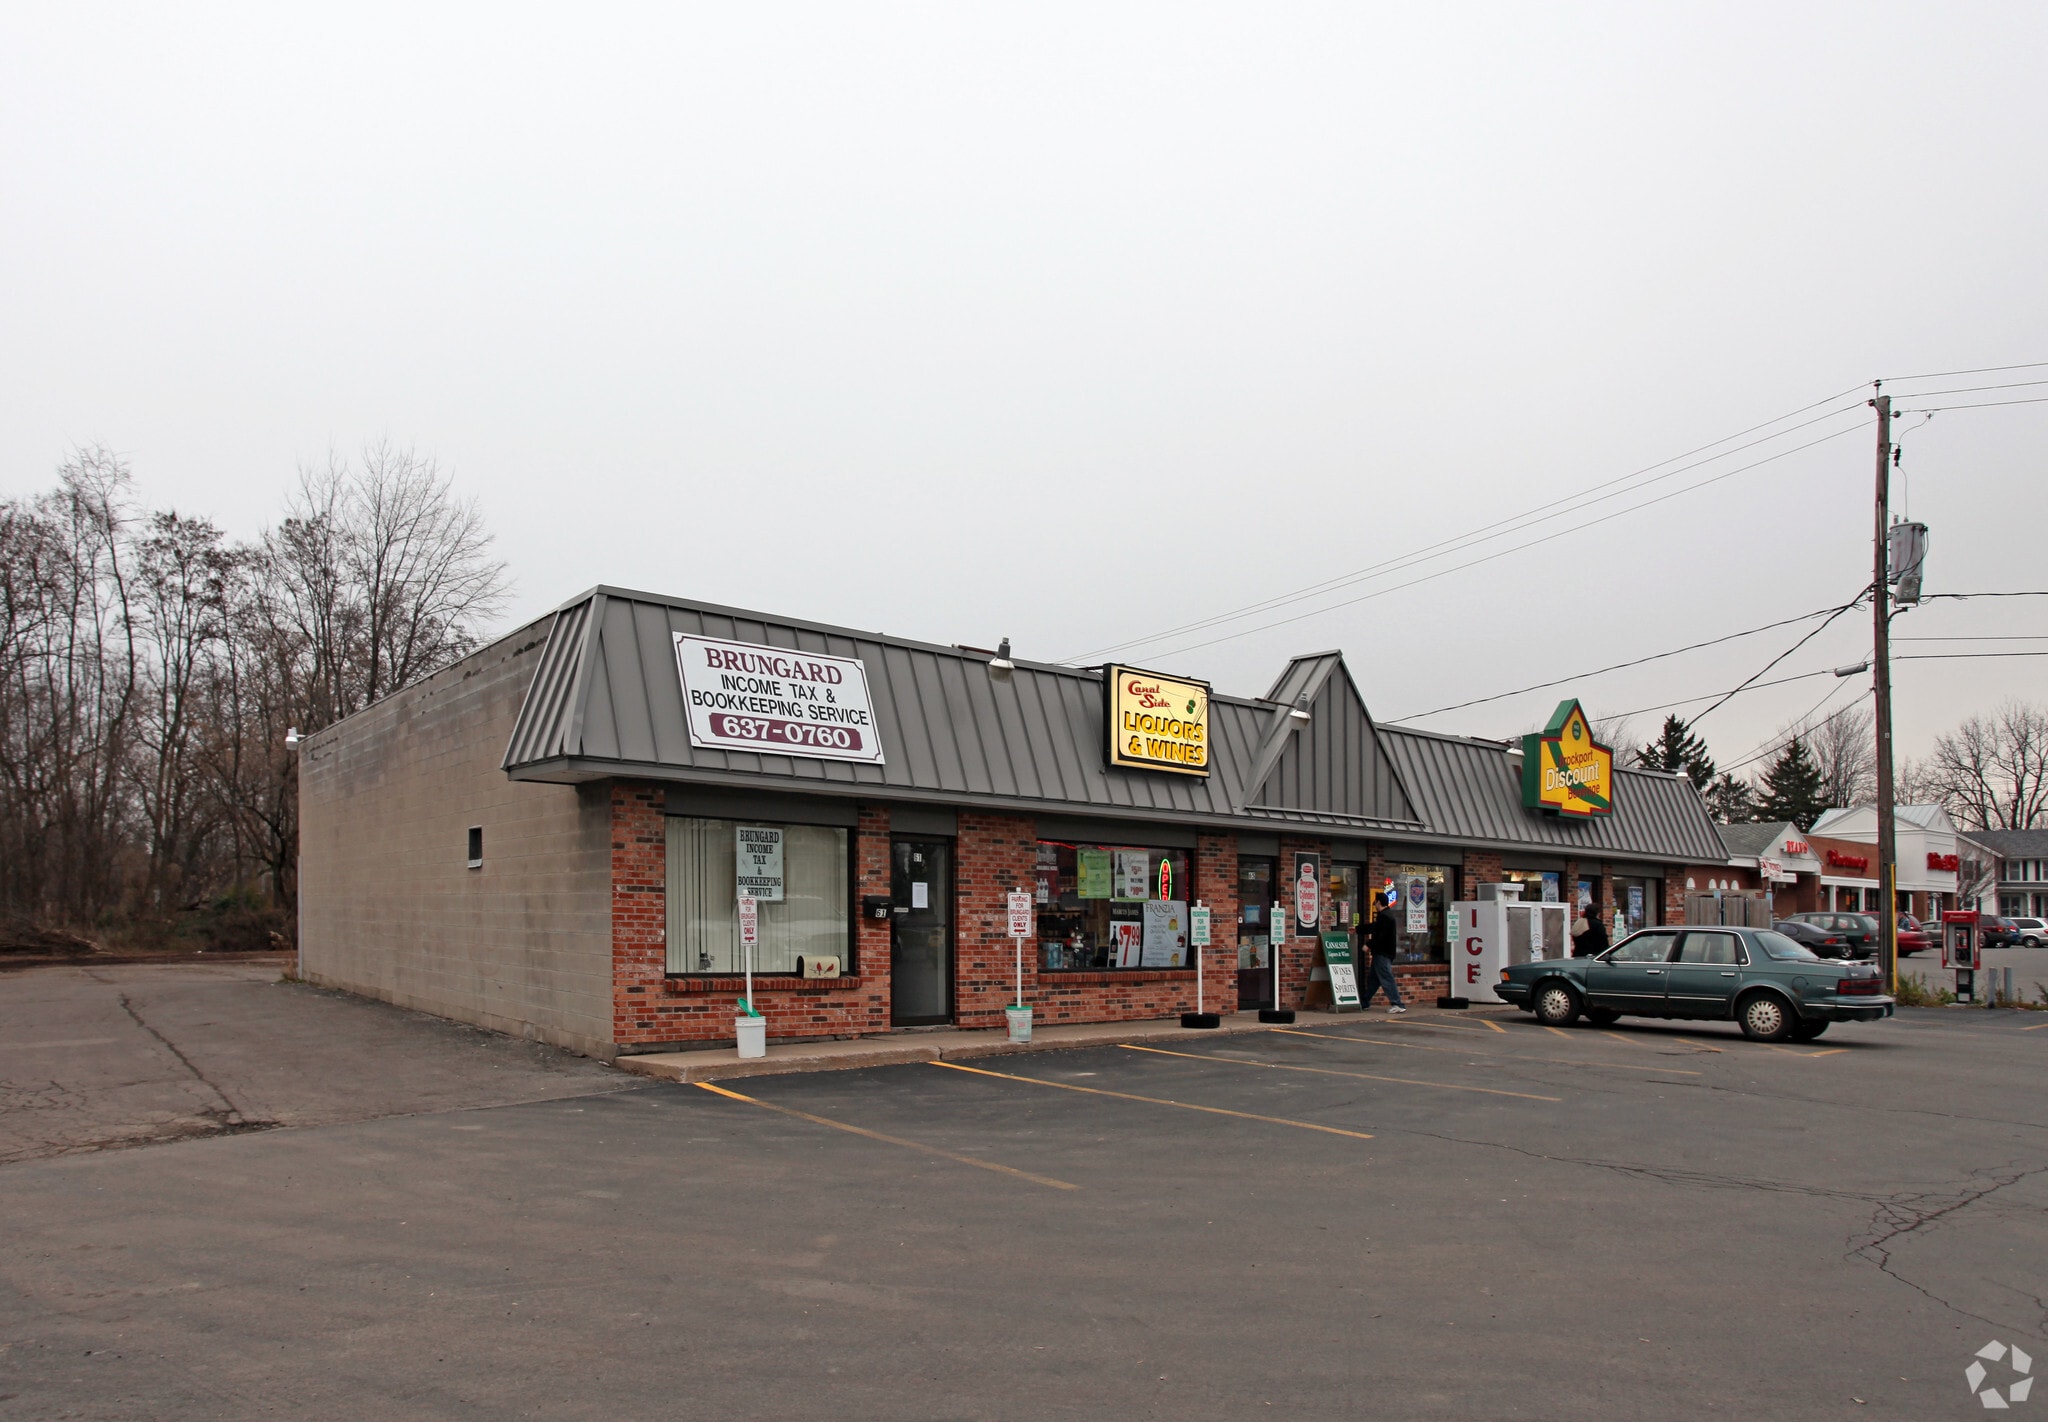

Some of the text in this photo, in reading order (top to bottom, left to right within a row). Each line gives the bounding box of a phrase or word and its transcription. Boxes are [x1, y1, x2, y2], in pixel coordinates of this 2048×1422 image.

[704, 647, 843, 685] BRUNGARD
[721, 674, 836, 703] INCOME TAX &
[1127, 680, 1161, 696] Canal
[1138, 693, 1171, 708] Side
[691, 690, 869, 726] BOOKKEEPING SERVICE
[722, 715, 851, 749] 637-0760
[1124, 711, 1204, 742] LIQUORS
[1128, 735, 1204, 765] & WINES
[1559, 750, 1594, 768] Brockport
[1546, 760, 1600, 791] Discount
[740, 829, 780, 843] BRUNGARD
[746, 843, 774, 854] INCOME
[753, 854, 767, 865] TAX
[757, 866, 762, 875] &
[738, 875, 782, 887] BOOKKEEPING
[1299, 879, 1315, 889] Propane
[748, 887, 773, 897] SERVICE
[1299, 890, 1316, 901] Cylinders
[875, 909, 886, 917] 61
[1145, 903, 1176, 918] FRANZIA
[743, 927, 754, 935] ONLY
[1325, 941, 1349, 949] CANALSIDE
[1465, 908, 1484, 985] ICE
[1332, 965, 1352, 976] WINES
[1342, 976, 1347, 984] &
[1334, 984, 1356, 994] SPIRITS
